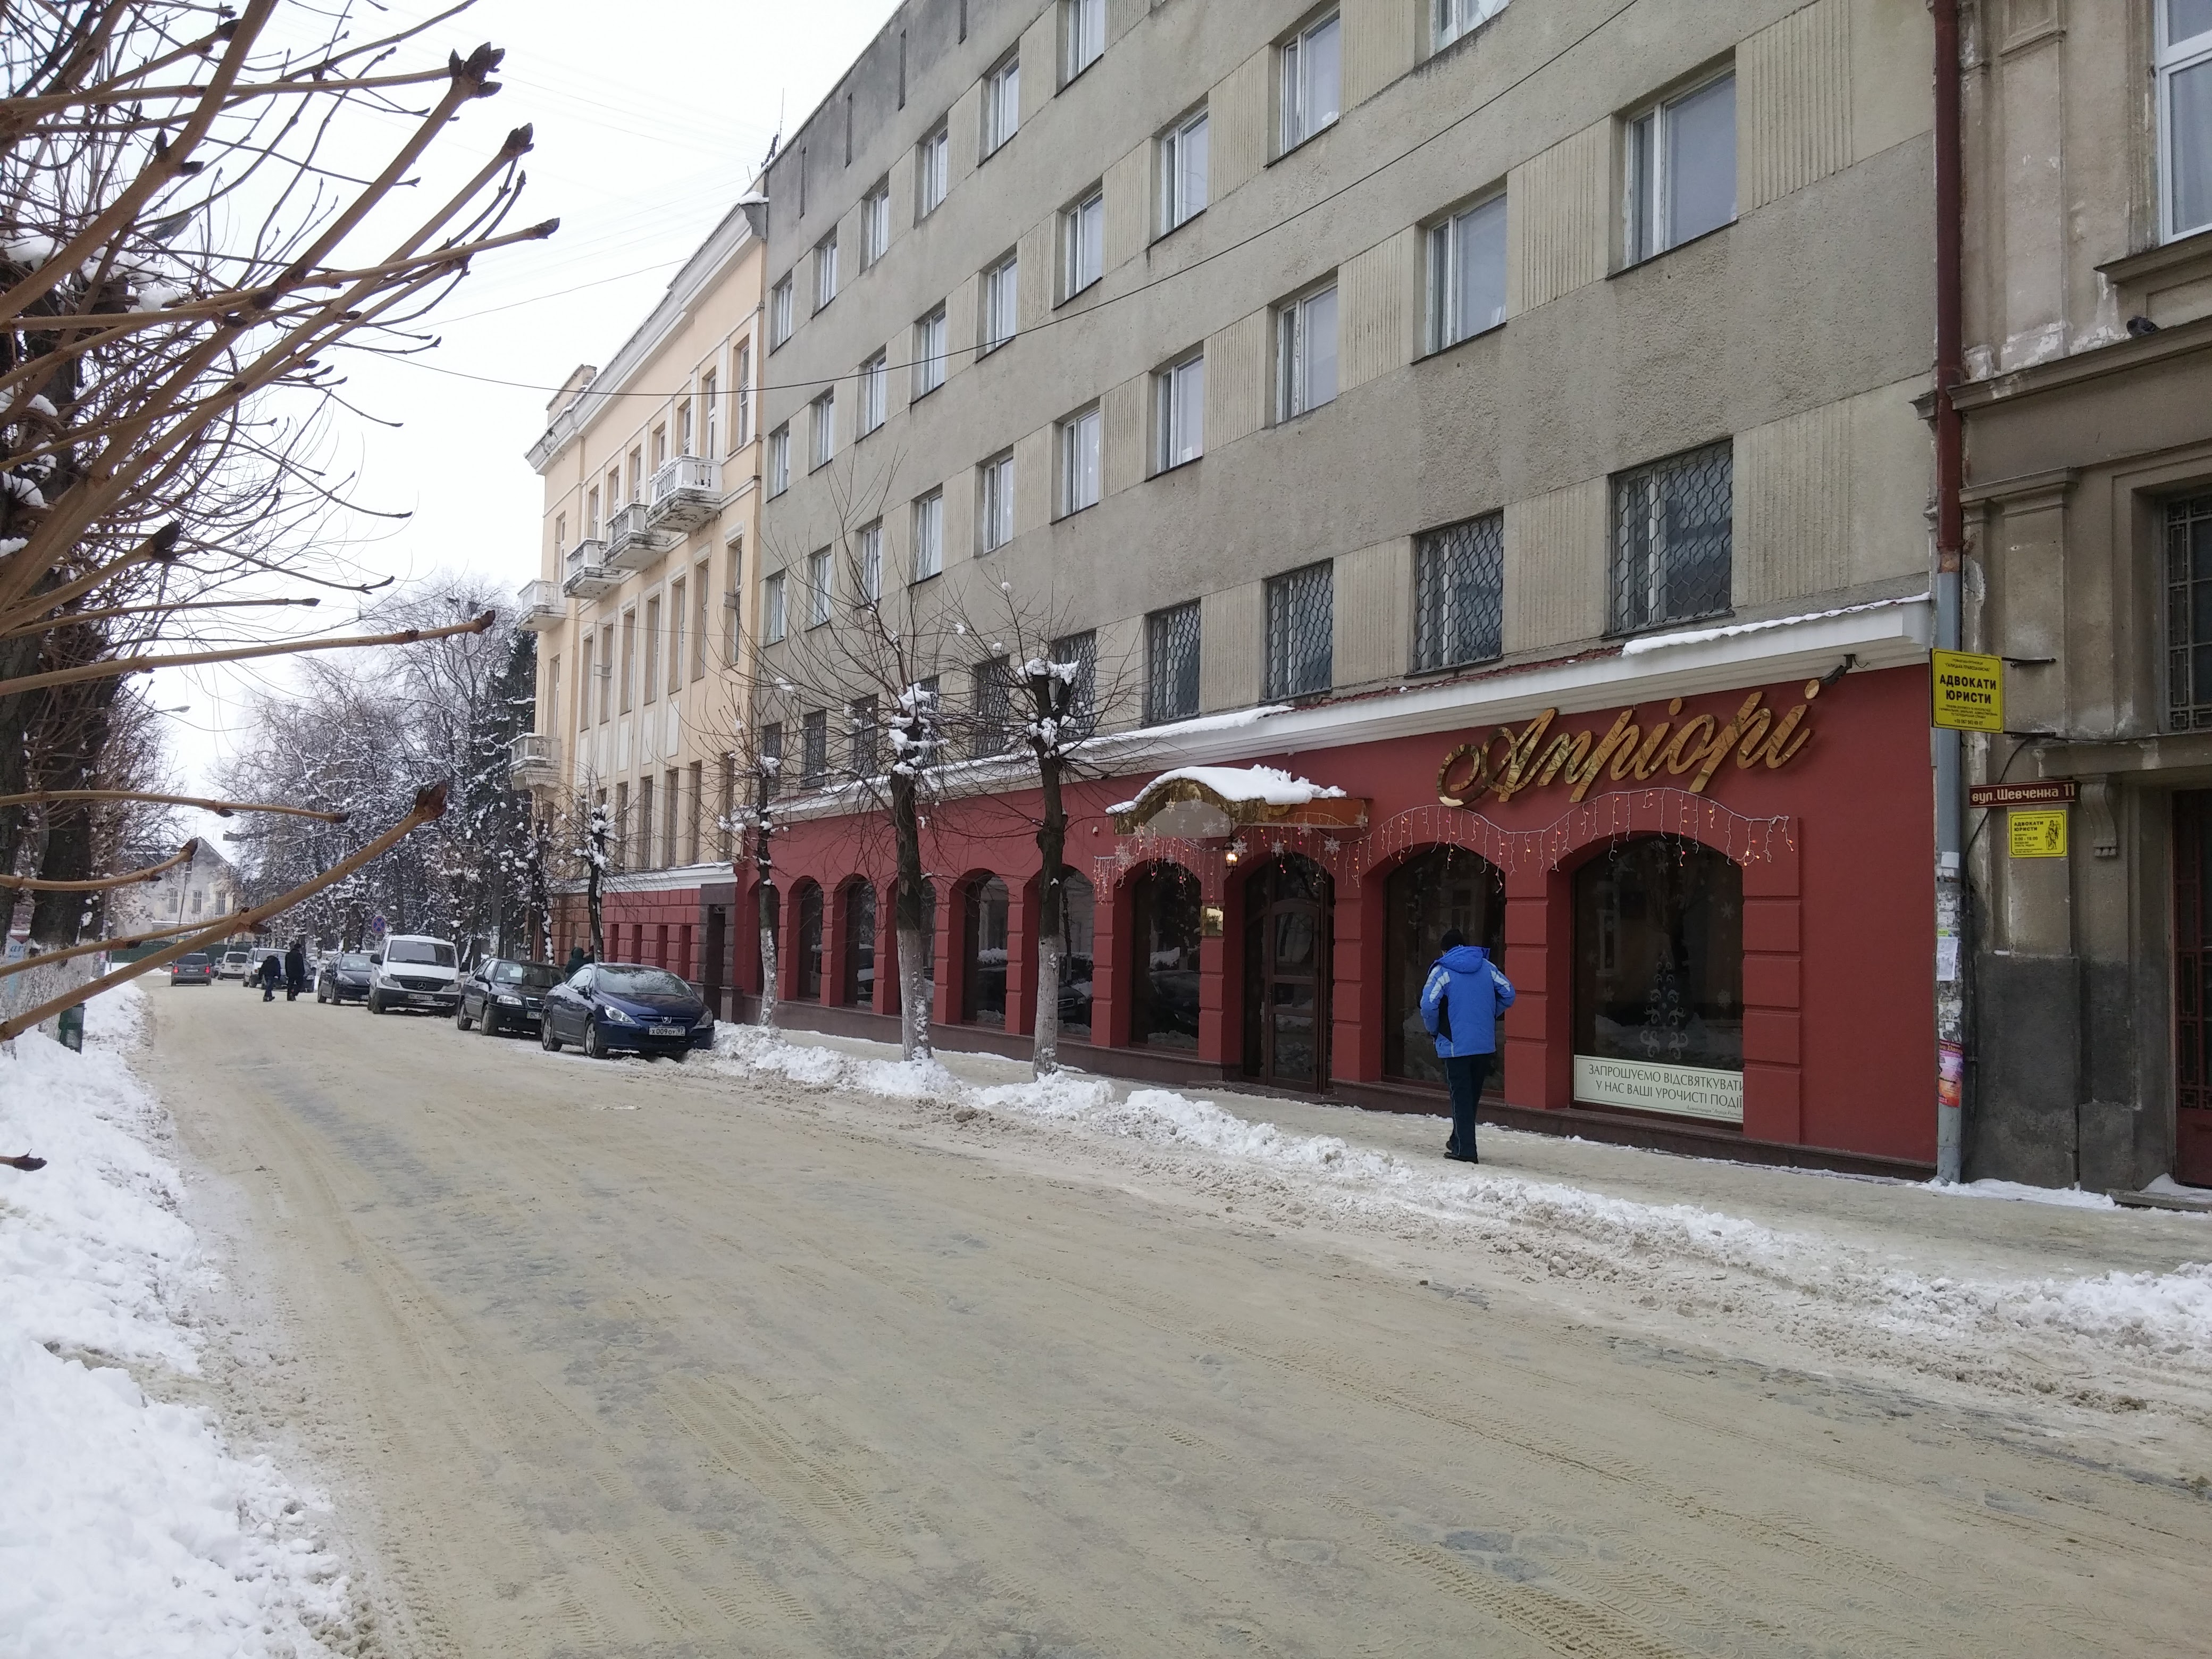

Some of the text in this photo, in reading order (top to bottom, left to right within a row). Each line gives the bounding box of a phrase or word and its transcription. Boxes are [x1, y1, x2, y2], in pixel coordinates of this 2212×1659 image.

[1940, 674, 1996, 690] АДВОКАТИ
[1946, 690, 1991, 704] ЮРИСТИ
[2063, 783, 2075, 797] 11
[1589, 1065, 1661, 1082] ЗАПРОШУЄМО
[1596, 1080, 1742, 1109] У НАС ВАШІ УРОЧИСТІ ПОДІЇ
